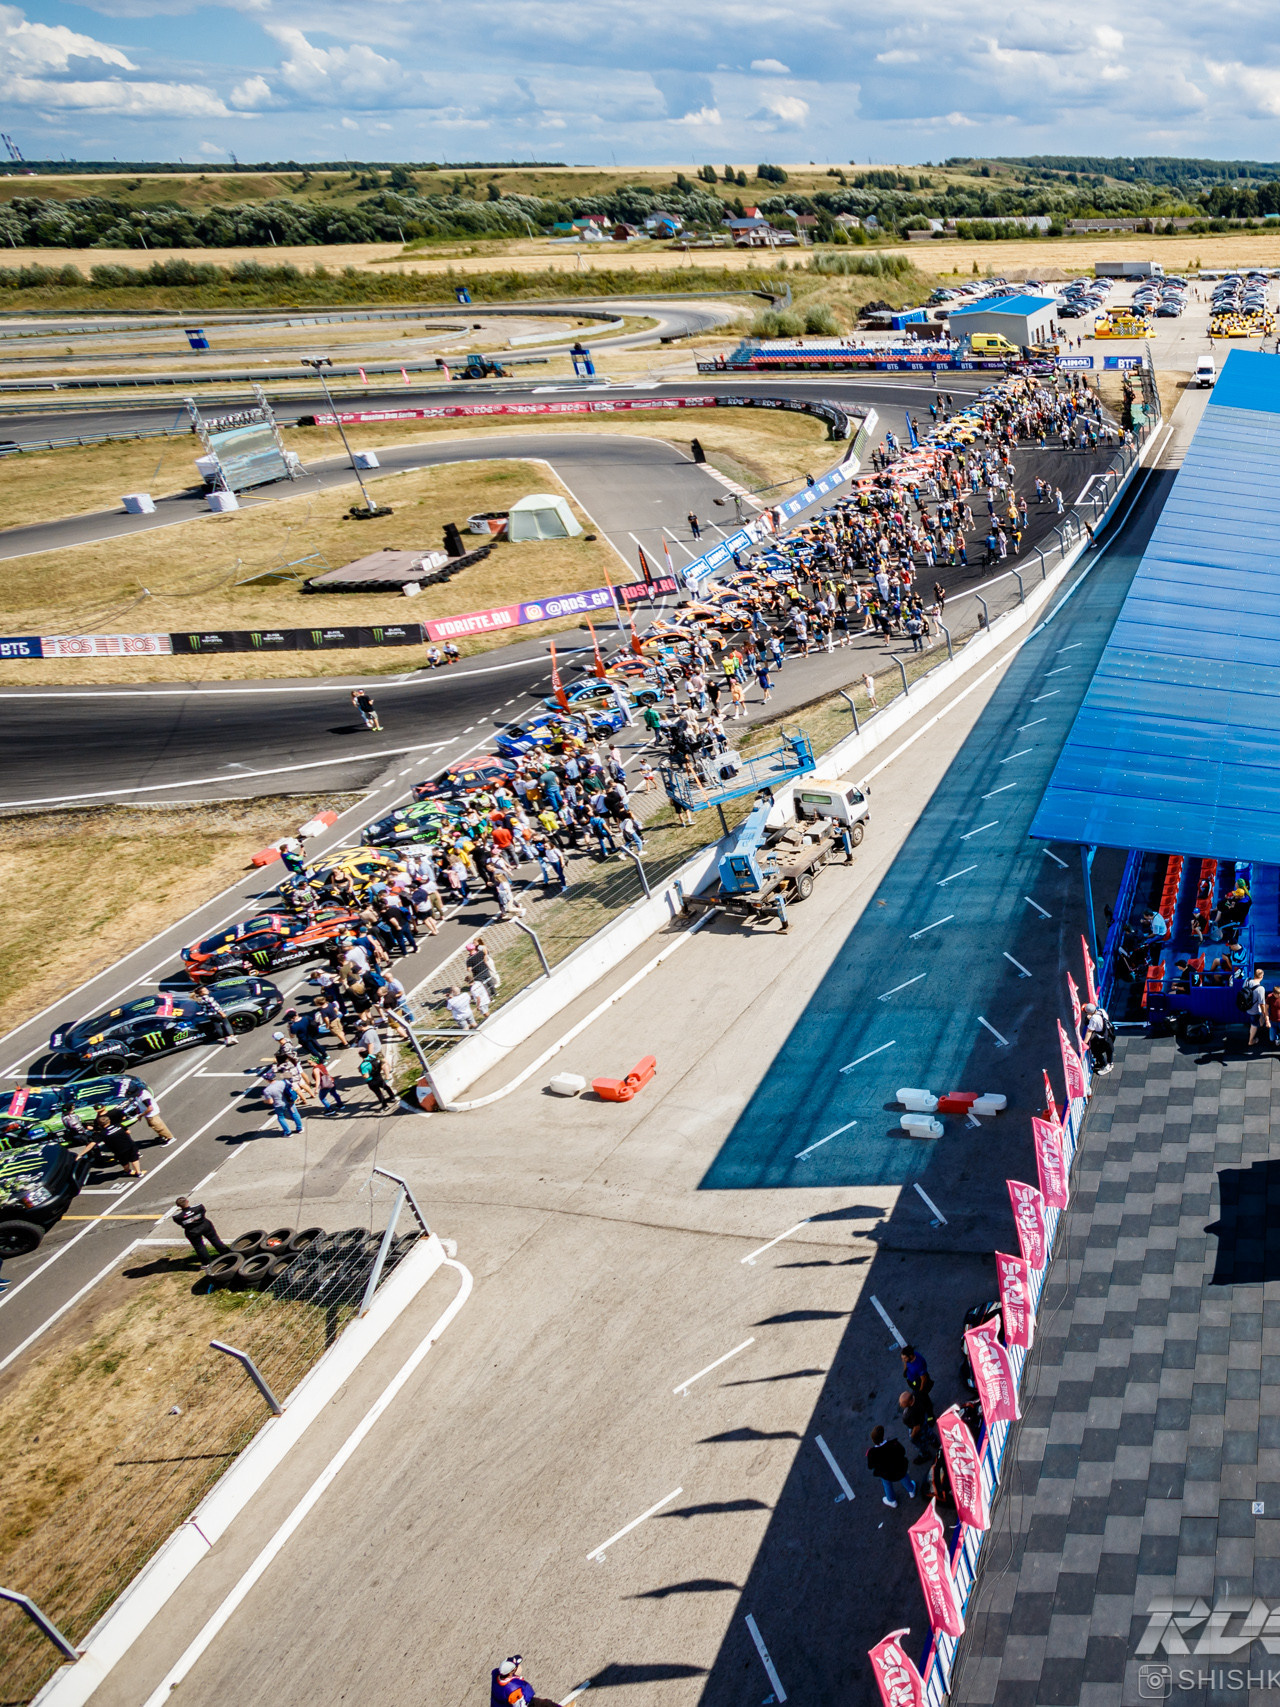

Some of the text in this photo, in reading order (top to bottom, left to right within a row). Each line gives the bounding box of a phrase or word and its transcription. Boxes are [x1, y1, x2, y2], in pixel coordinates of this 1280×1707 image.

[546, 593, 609, 617] @RDS_GP
[434, 612, 512, 637] VDRIFTE.RU
[59, 639, 93, 654] ROS
[123, 637, 156, 652] ROS
[1014, 1187, 1038, 1230] RDS
[1001, 1261, 1024, 1305] RDS
[972, 1331, 1005, 1382] RDS
